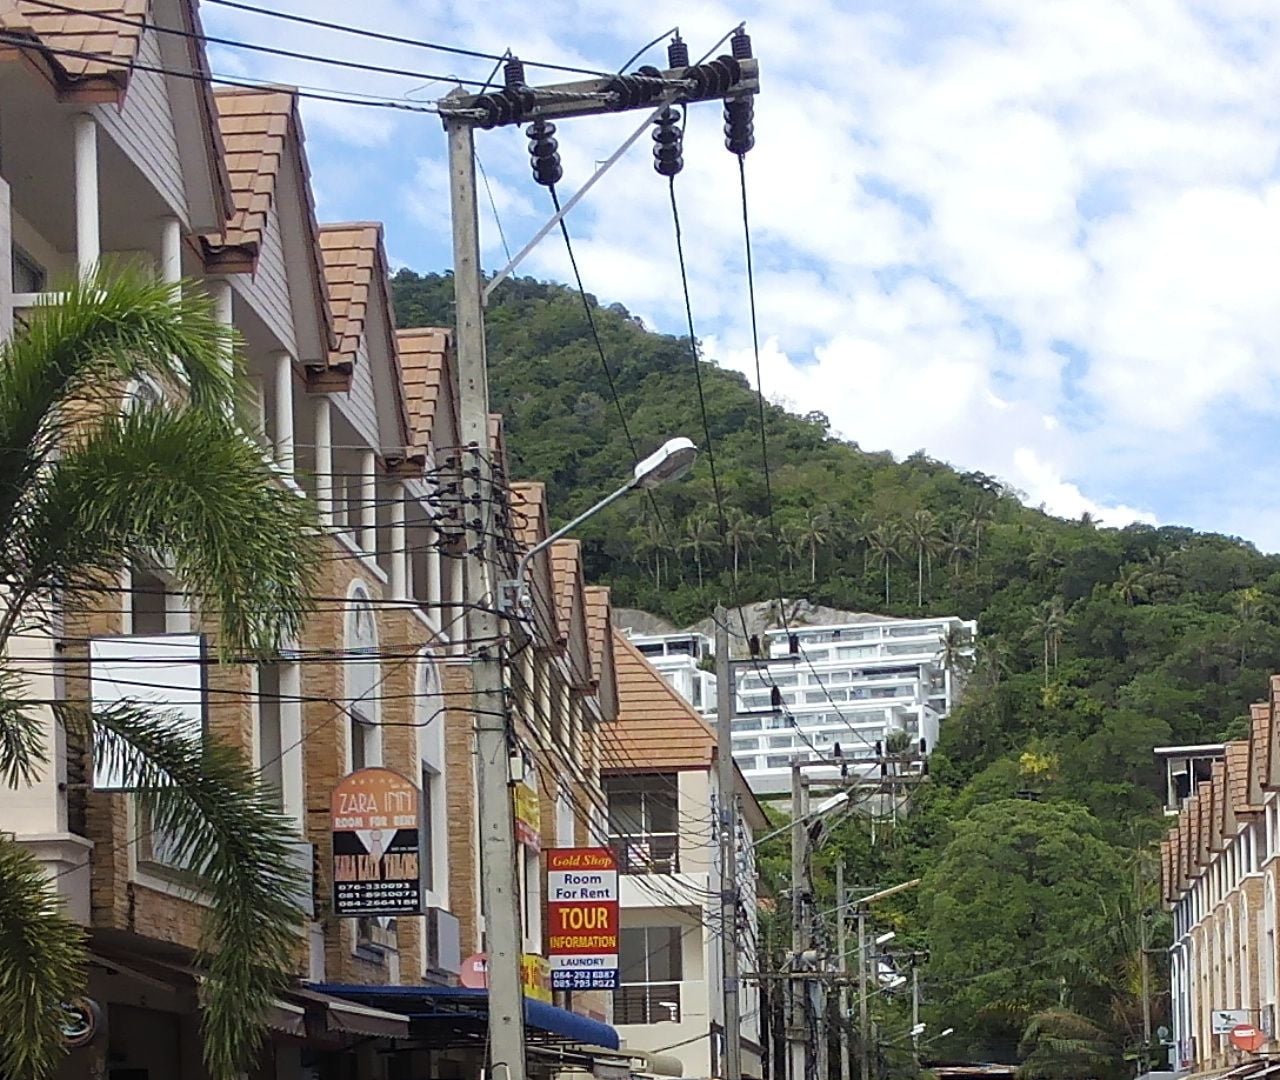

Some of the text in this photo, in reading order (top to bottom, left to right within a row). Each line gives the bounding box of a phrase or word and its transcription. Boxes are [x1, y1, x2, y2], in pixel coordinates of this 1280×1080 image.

[339, 791, 411, 814] ZARA INN
[335, 815, 416, 828] ROOM FOR RENT
[553, 854, 612, 868] Gold Shop
[564, 874, 602, 884] Room
[556, 888, 610, 899] For Rent
[559, 907, 608, 929] TOUR
[550, 936, 616, 948] INFORMATION
[561, 958, 604, 966] LAUNDRY
